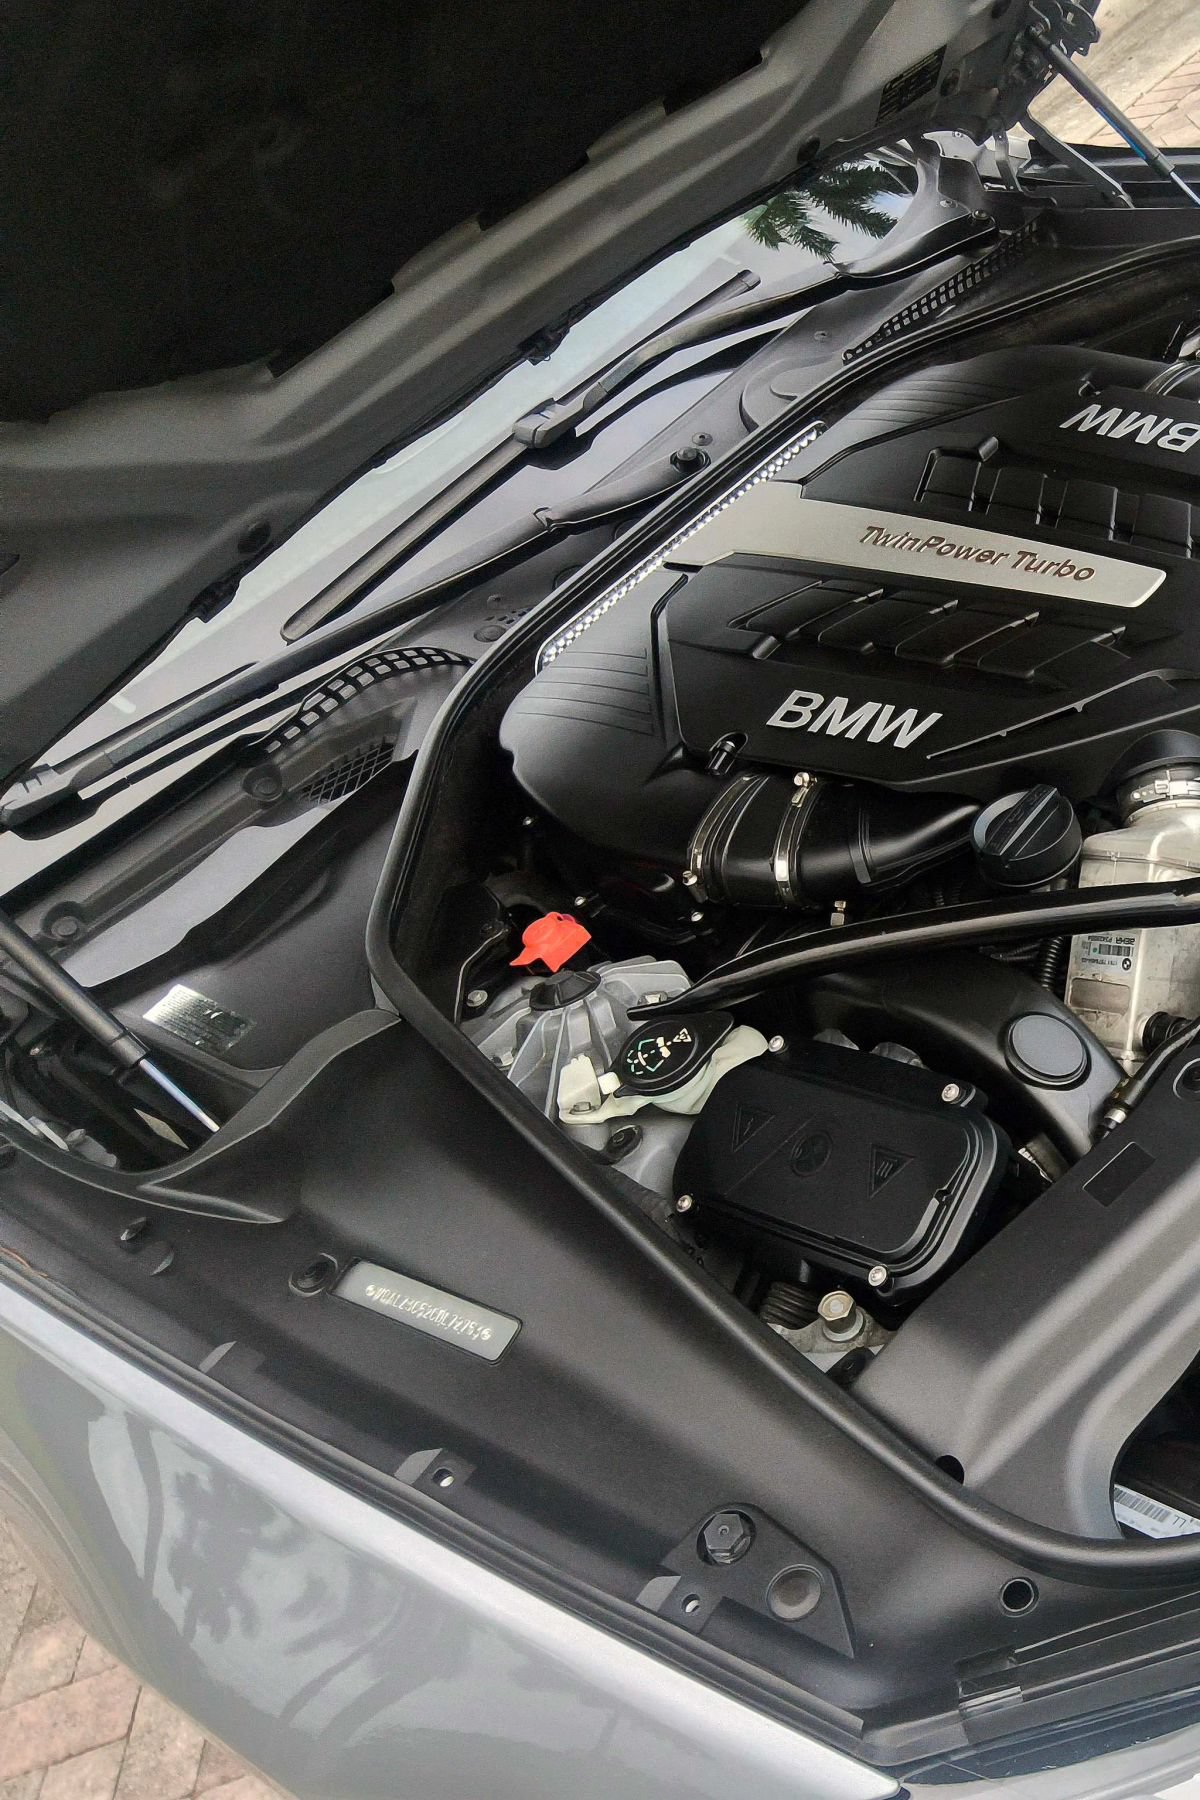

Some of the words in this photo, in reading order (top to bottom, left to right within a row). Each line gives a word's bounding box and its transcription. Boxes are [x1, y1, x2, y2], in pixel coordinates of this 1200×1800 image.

[860, 526, 1010, 566] TwinPower
[1011, 550, 1097, 582] Turbo
[766, 689, 944, 749] BMW
